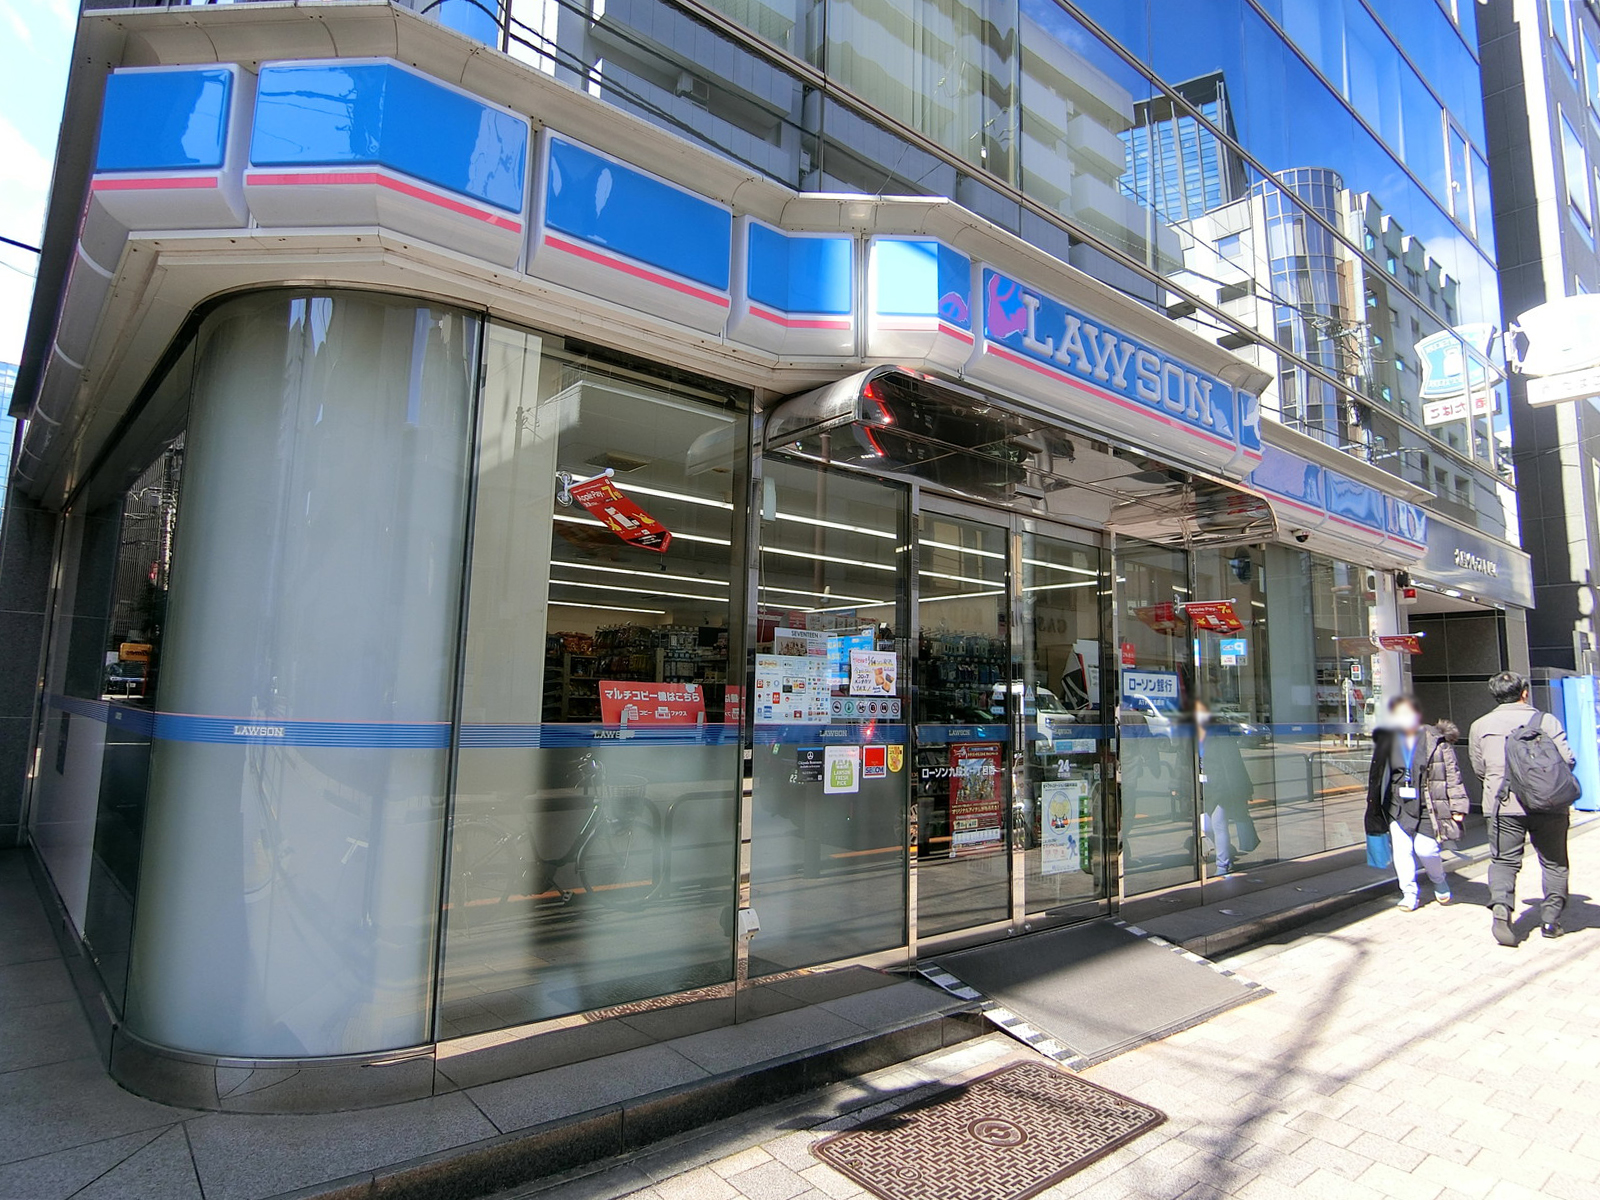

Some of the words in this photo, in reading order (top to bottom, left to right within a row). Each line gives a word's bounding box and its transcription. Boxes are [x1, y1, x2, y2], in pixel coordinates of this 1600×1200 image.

[1022, 292, 1213, 426] LAWSON
[791, 630, 818, 638] SEVENTEEN
[1128, 678, 1173, 693] ローソン銀行
[605, 687, 700, 703] マルチコピー機はこちら
[233, 725, 285, 737] LAWSON
[819, 729, 848, 737] LAWSON
[1058, 759, 1070, 772] 24
